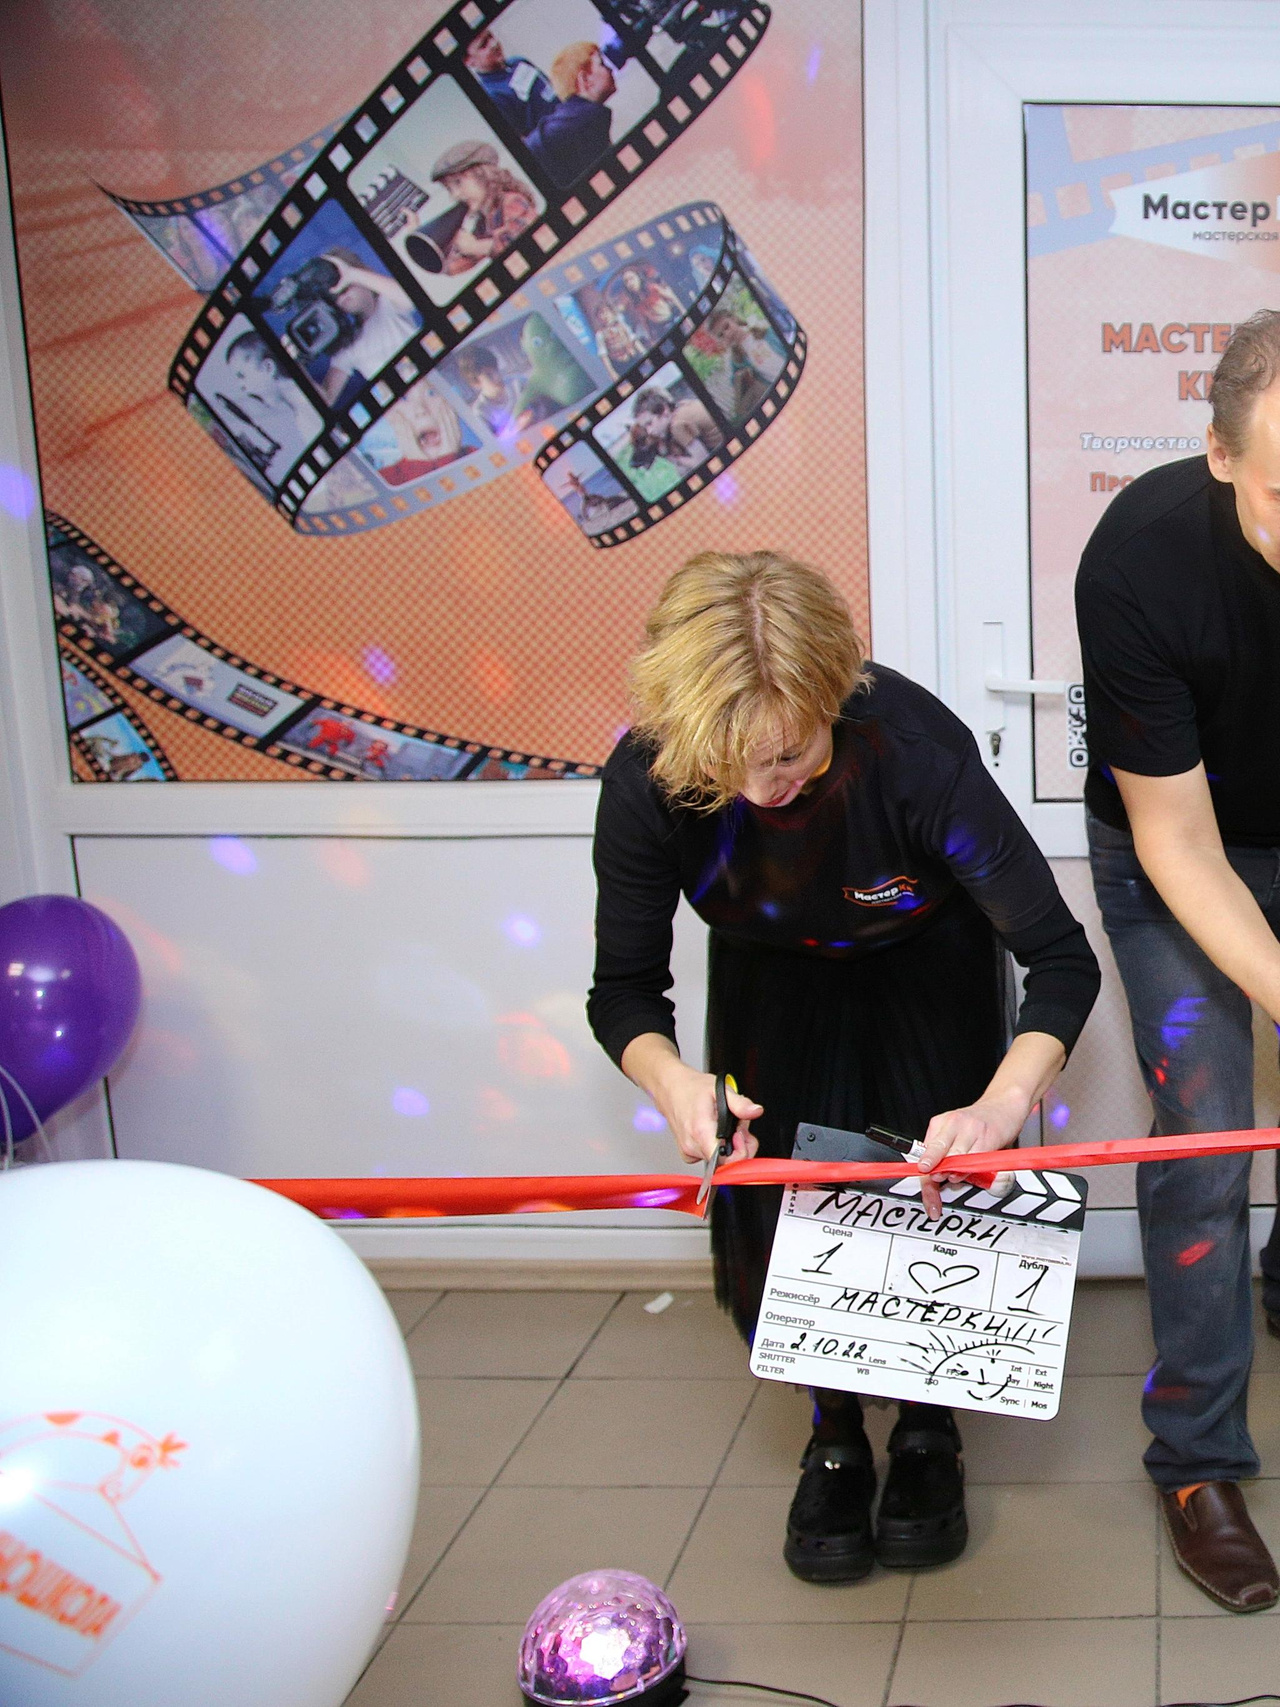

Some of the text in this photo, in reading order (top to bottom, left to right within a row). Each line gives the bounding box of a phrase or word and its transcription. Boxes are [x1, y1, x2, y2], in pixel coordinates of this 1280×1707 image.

[1101, 322, 1240, 353] МАСТЕ
[1080, 433, 1201, 453] Творчество
[822, 1225, 853, 1238] Сцена
[933, 1244, 958, 1257] Кадр
[801, 1242, 843, 1275] 1
[770, 1288, 820, 1304] Режиссёр
[1007, 1265, 1049, 1315] 1
[765, 1311, 815, 1328] Оператор
[761, 1338, 785, 1349] Дата
[790, 1332, 868, 1360] 2.10.22
[759, 1352, 796, 1364] SHUTTER
[868, 1356, 887, 1365] Lens
[756, 1364, 785, 1375] FILTER
[857, 1367, 870, 1376] WB
[1010, 1364, 1048, 1377] Int Ext
[1033, 1380, 1054, 1390] Night
[1000, 1396, 1048, 1410] Sync Mos
